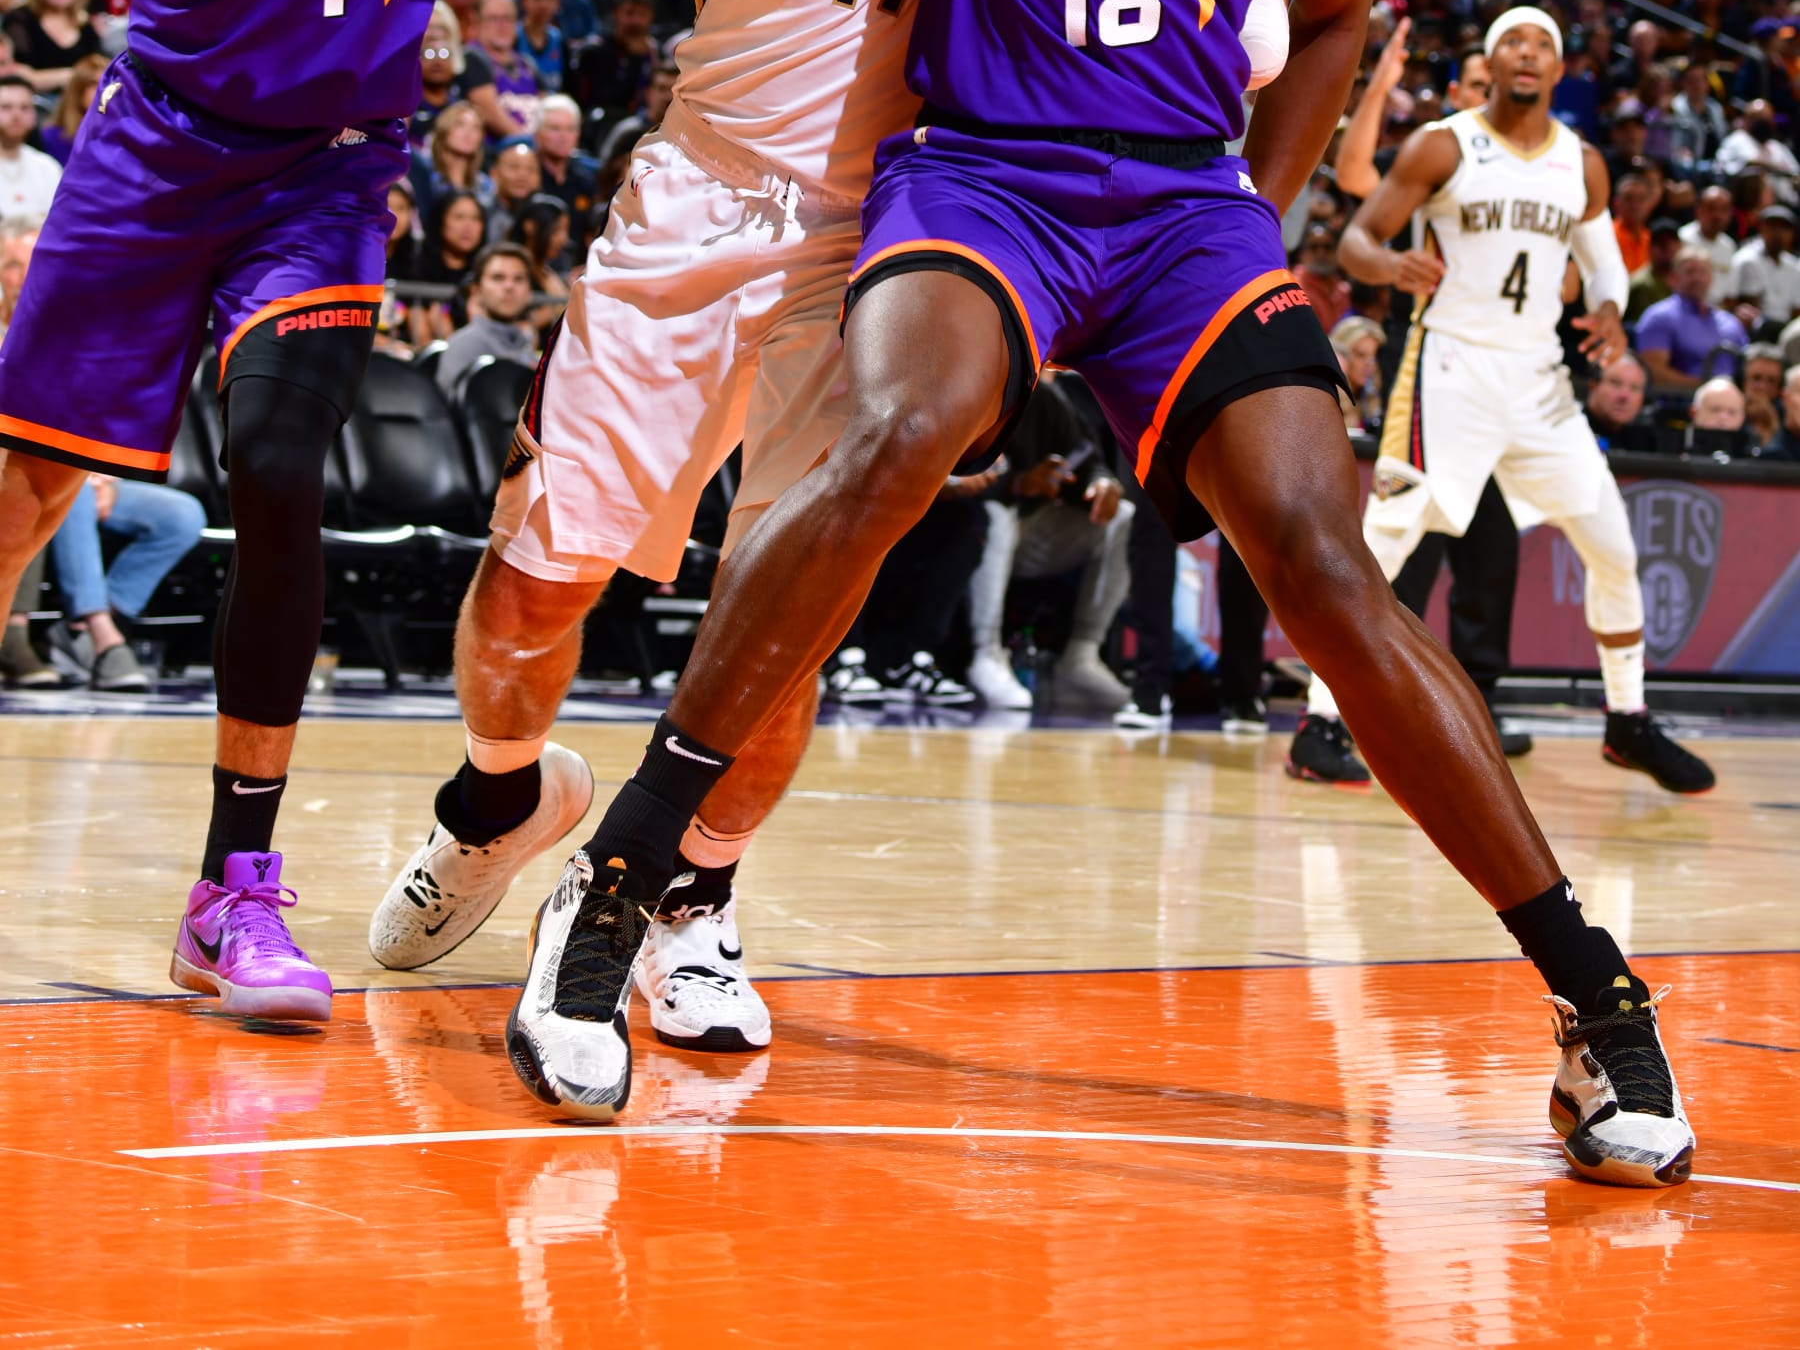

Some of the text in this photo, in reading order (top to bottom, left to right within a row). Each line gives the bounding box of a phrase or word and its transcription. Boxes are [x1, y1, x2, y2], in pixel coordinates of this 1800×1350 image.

[1460, 199, 1505, 233] NEW
[1500, 250, 1530, 314] 4
[276, 308, 373, 337] PHOENIX
